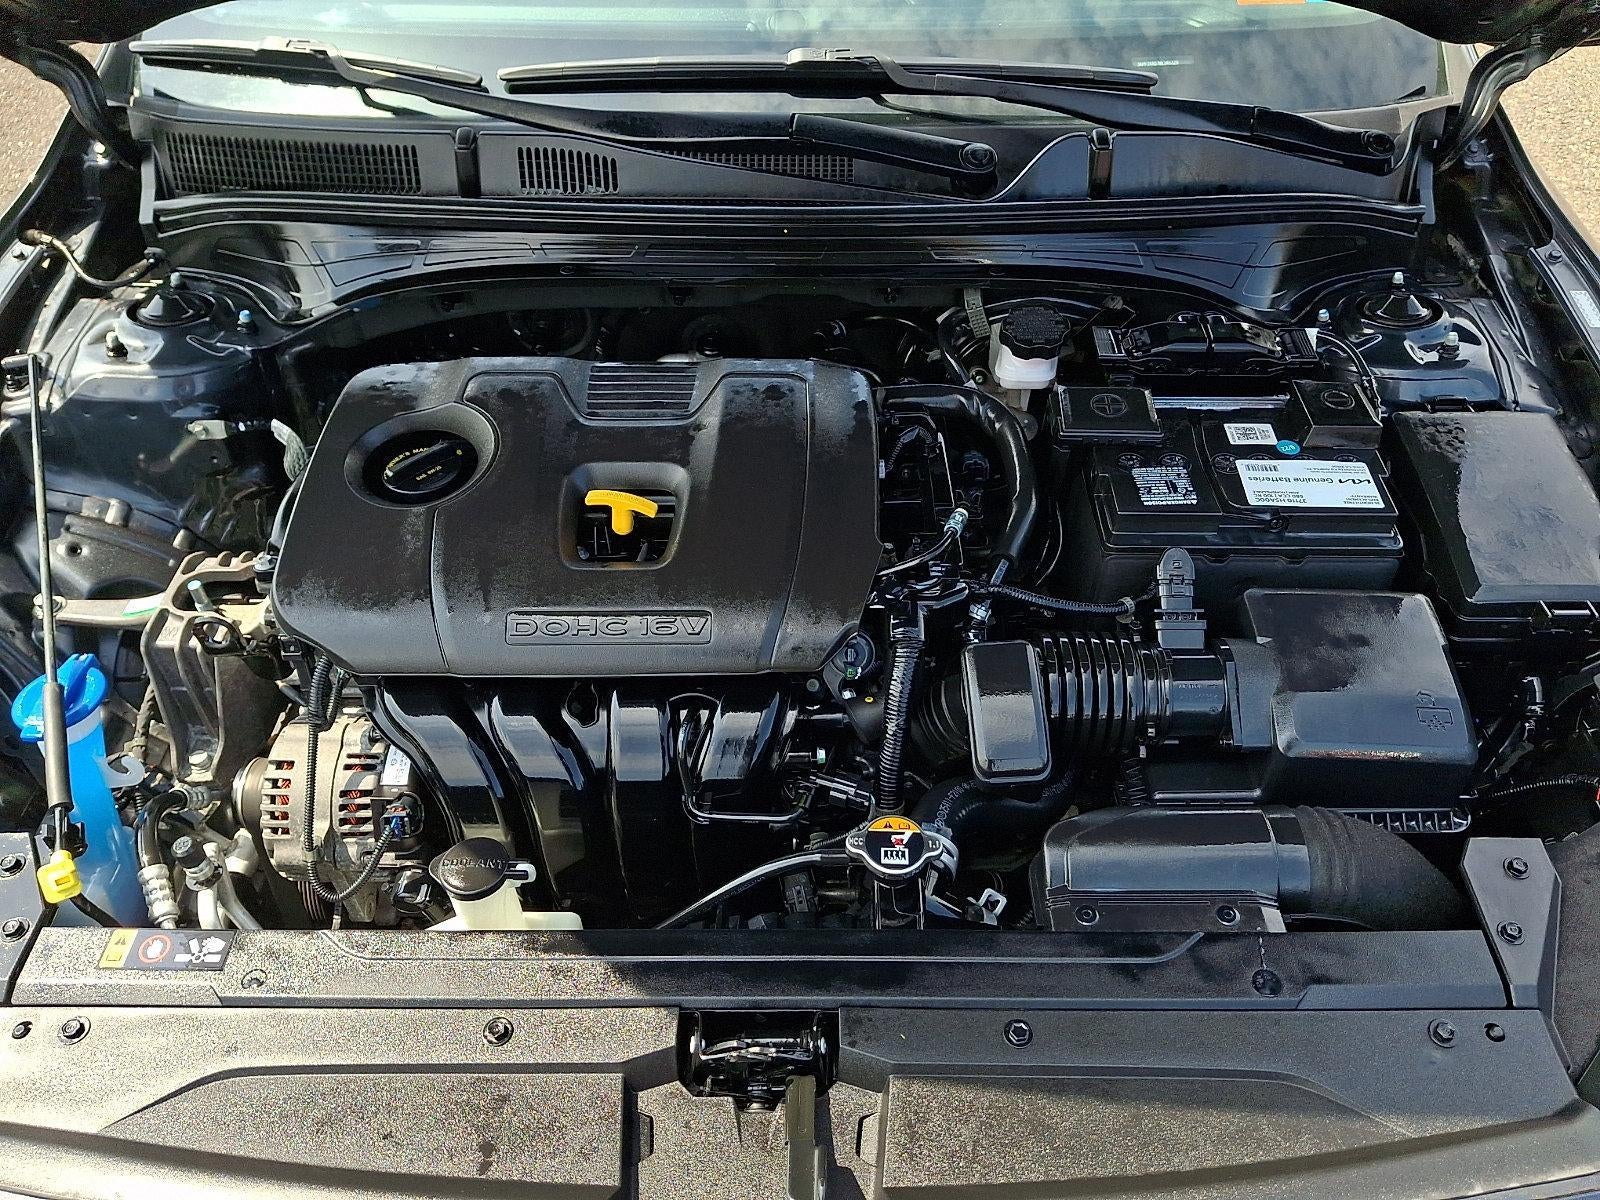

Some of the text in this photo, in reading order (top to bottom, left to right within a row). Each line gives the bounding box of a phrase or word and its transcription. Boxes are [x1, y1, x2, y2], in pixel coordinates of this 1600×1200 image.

[509, 617, 709, 637] DOHC 16V
[848, 837, 940, 848] HCC 1.1
[442, 857, 505, 869] COOLANT
